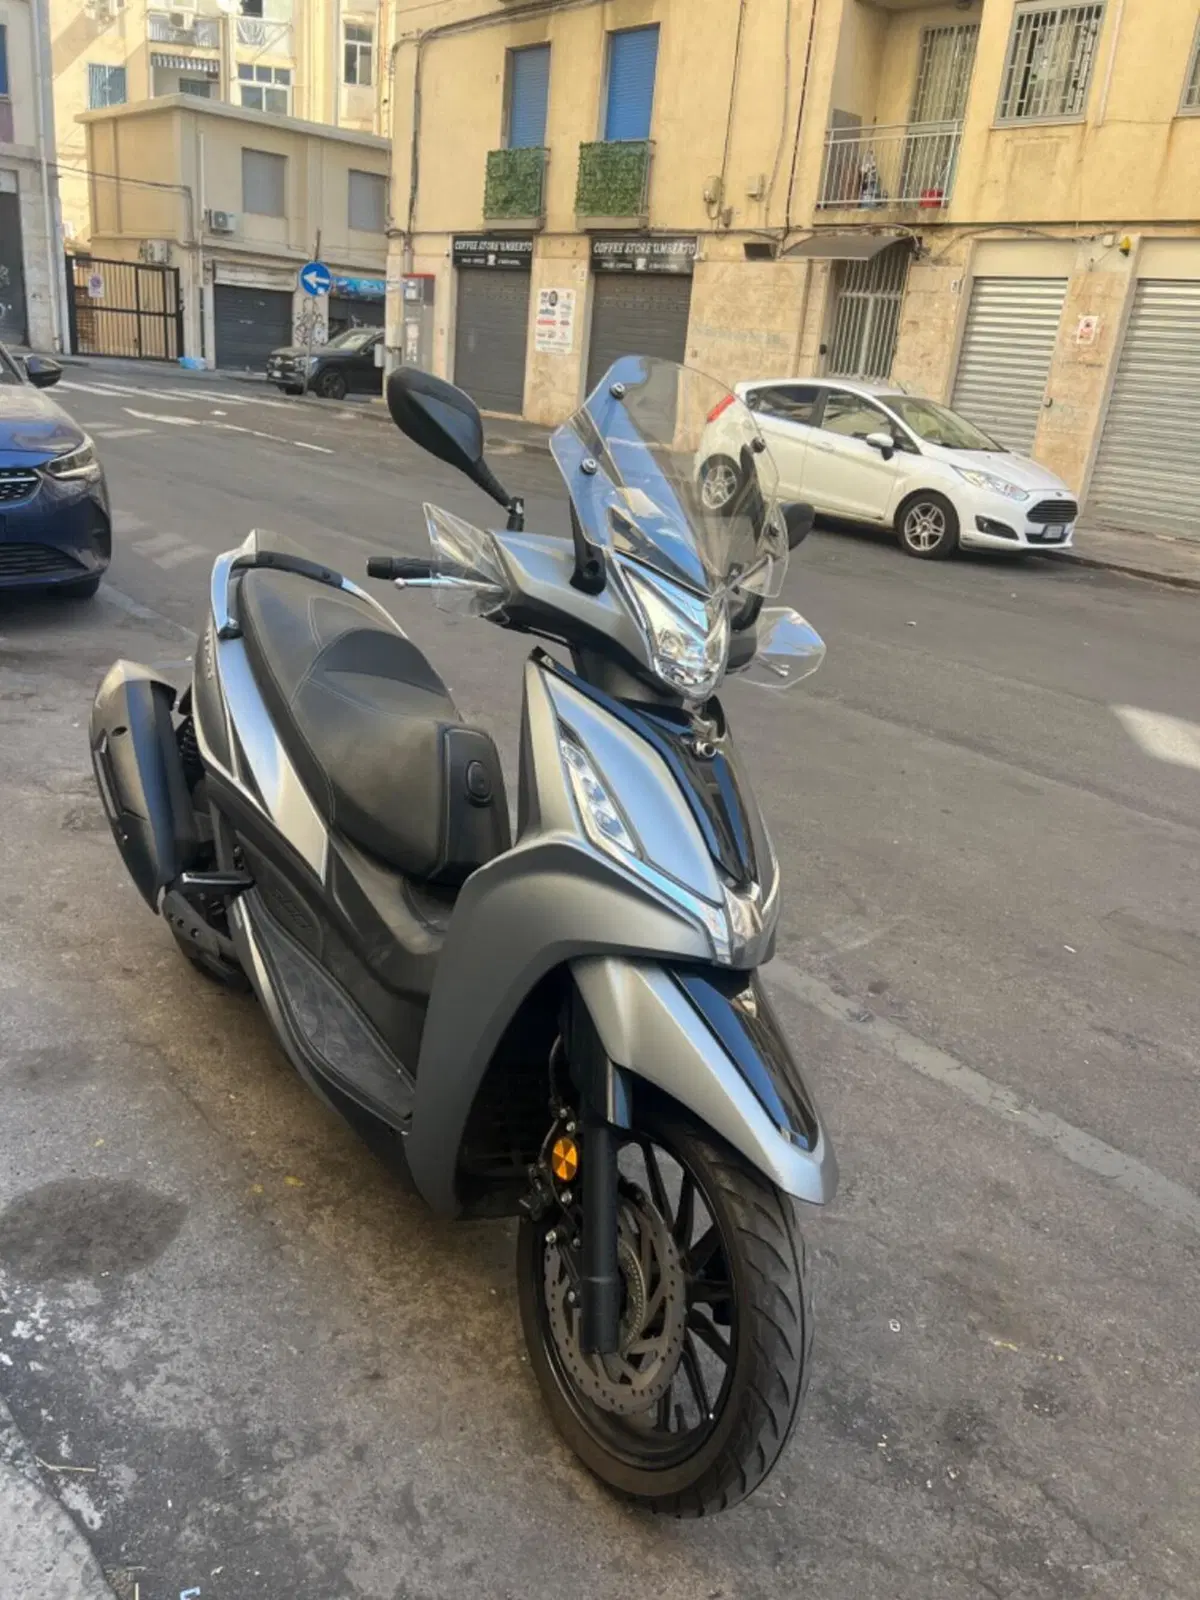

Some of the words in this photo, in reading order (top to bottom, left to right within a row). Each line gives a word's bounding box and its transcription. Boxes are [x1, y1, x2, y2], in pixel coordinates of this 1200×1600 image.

[455, 240, 479, 250] COFFEE
[593, 242, 624, 254] COFFEE
[624, 242, 653, 254] STORE
